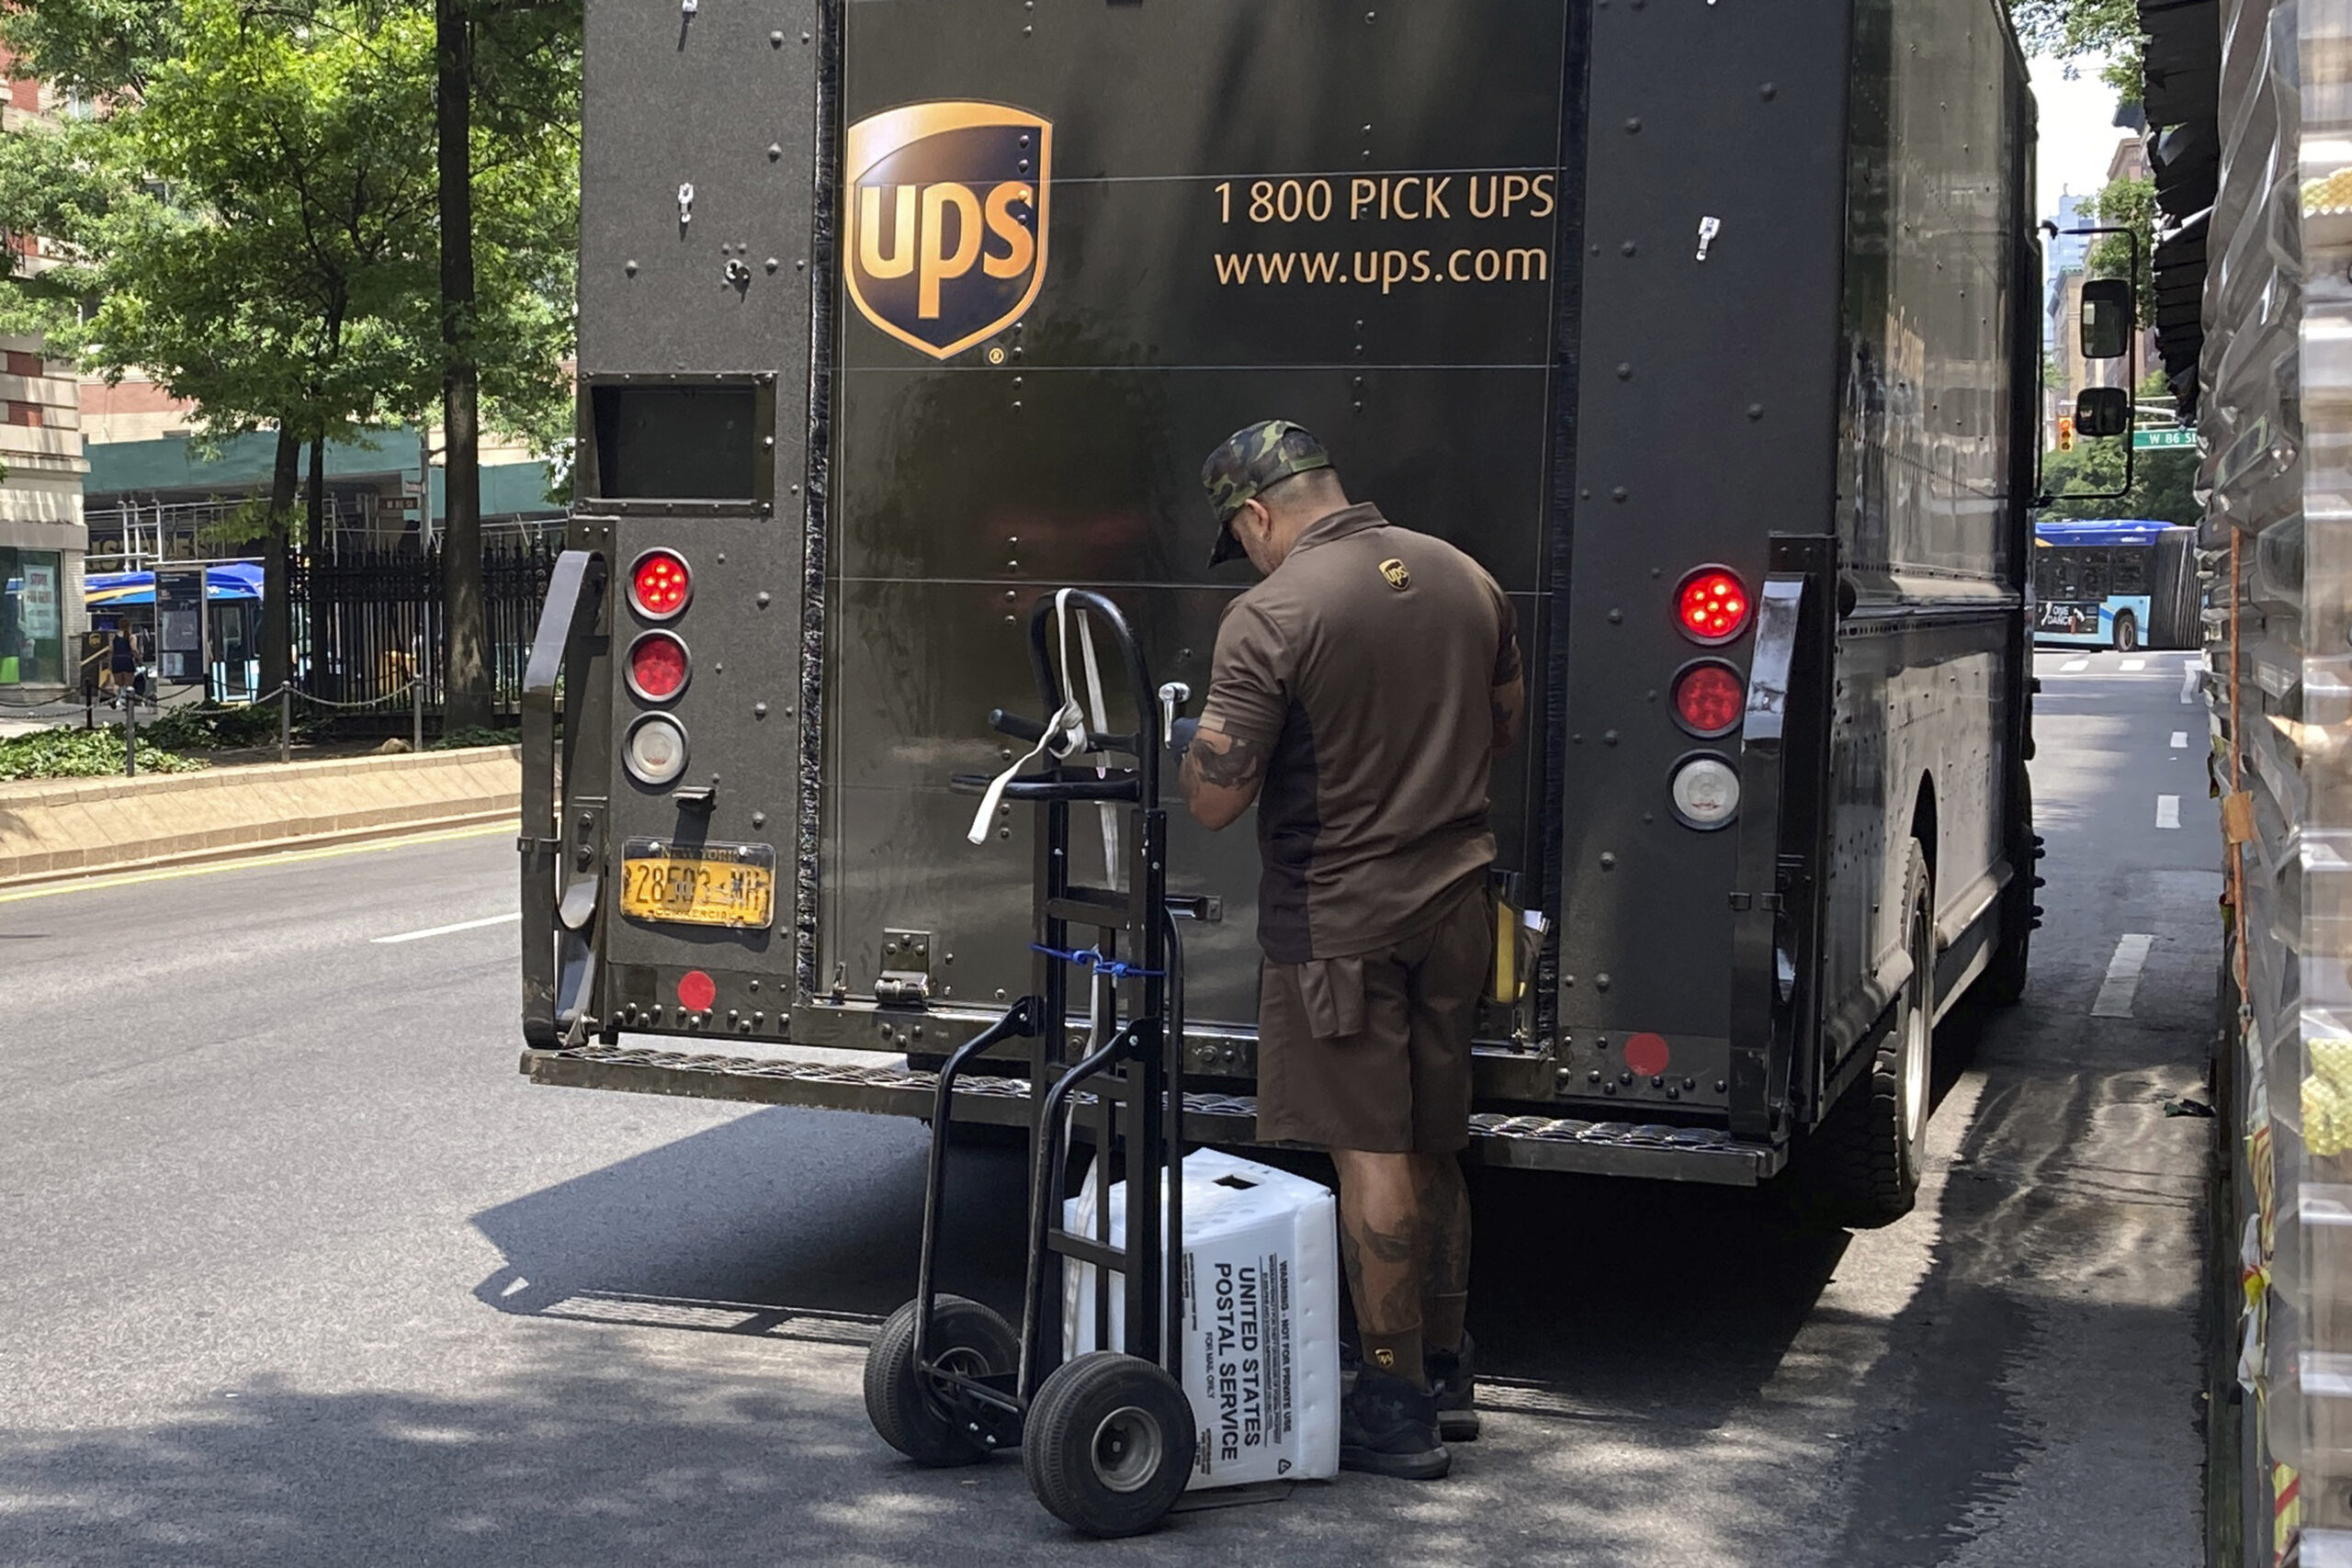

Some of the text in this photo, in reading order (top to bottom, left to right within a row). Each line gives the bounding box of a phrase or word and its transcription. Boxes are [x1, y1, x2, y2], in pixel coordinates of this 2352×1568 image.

[1215, 174, 1555, 223] 1 800 PICK UPS
[859, 181, 1036, 319] ups
[1214, 247, 1547, 295] www.ups.com
[2149, 433, 2160, 445] W
[2165, 433, 2180, 445] 86
[1205, 1332, 1214, 1351] FOR
[1281, 1319, 1290, 1340] NOT
[1214, 1262, 1238, 1461] POSTAL SERVICE
[1238, 1267, 1261, 1447] UNITED STATES
[1282, 1343, 1291, 1366] FOR
[1282, 1367, 1292, 1410] PRIVATE
[1283, 1411, 1292, 1433] USE
